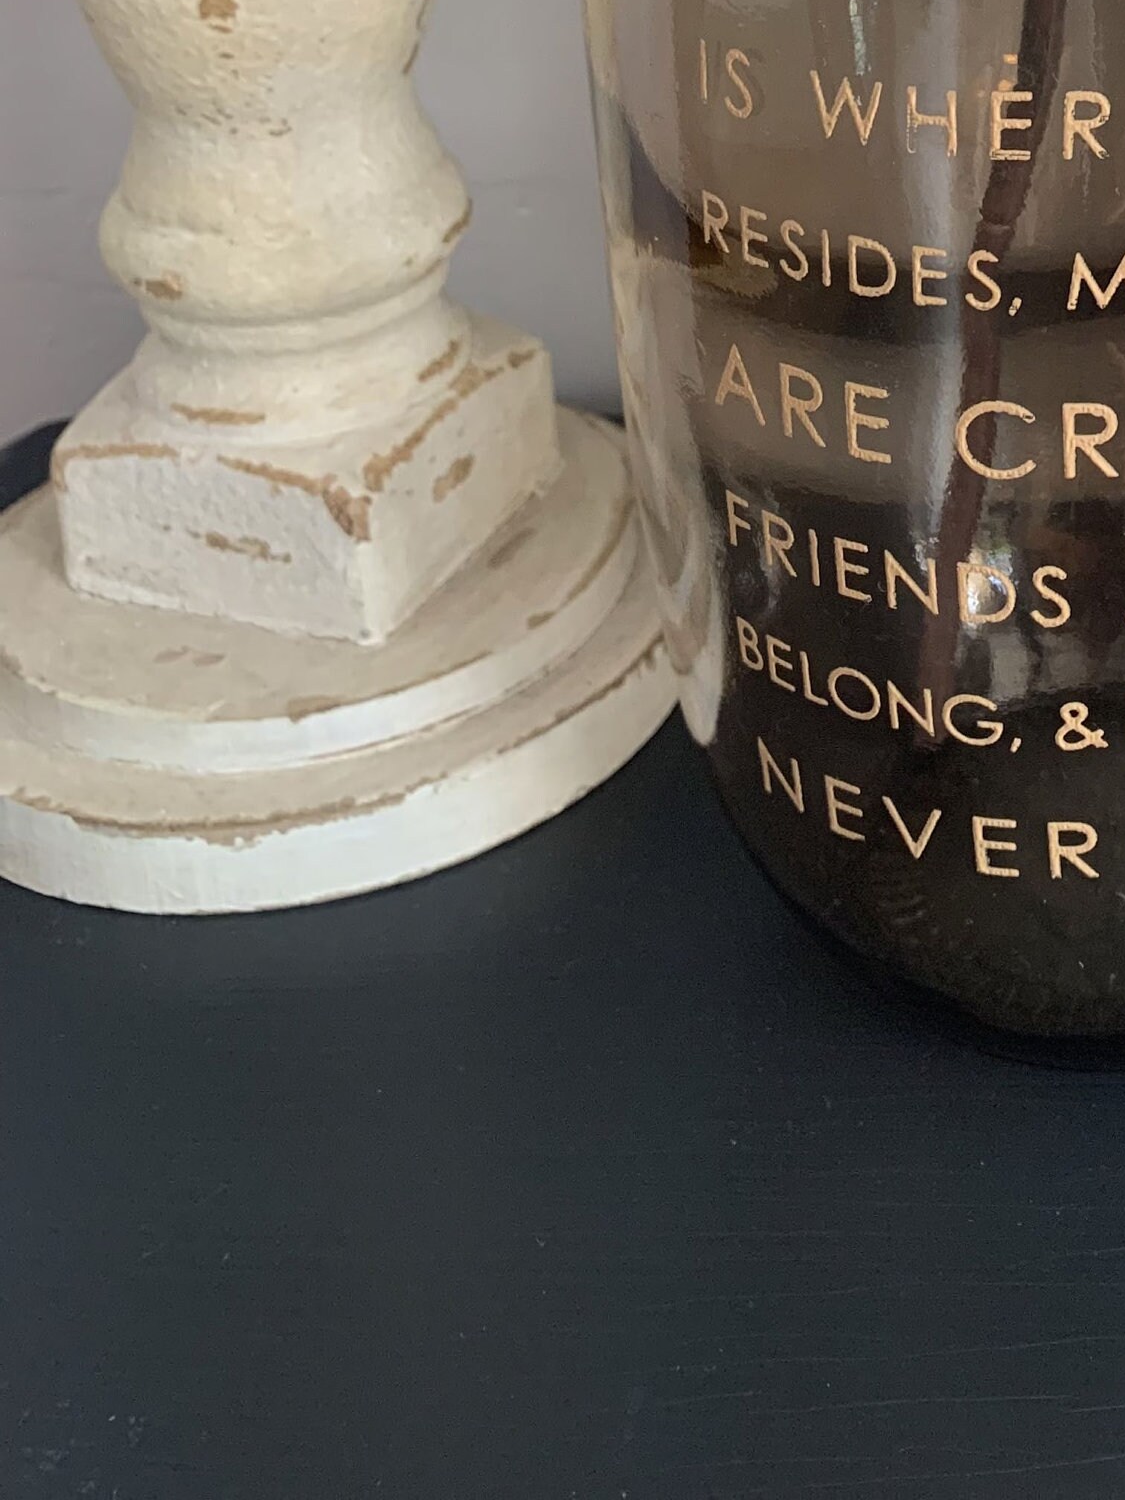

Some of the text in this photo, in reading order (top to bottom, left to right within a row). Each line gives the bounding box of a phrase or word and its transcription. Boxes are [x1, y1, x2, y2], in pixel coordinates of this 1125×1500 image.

[697, 38, 755, 119] IS
[702, 191, 1023, 318] RESIDES,
[714, 343, 893, 466] ARE
[724, 488, 1074, 628] FRIENDS
[734, 615, 1022, 755] BELONG,
[1054, 702, 1110, 752] &
[756, 736, 1100, 880] NEVER
